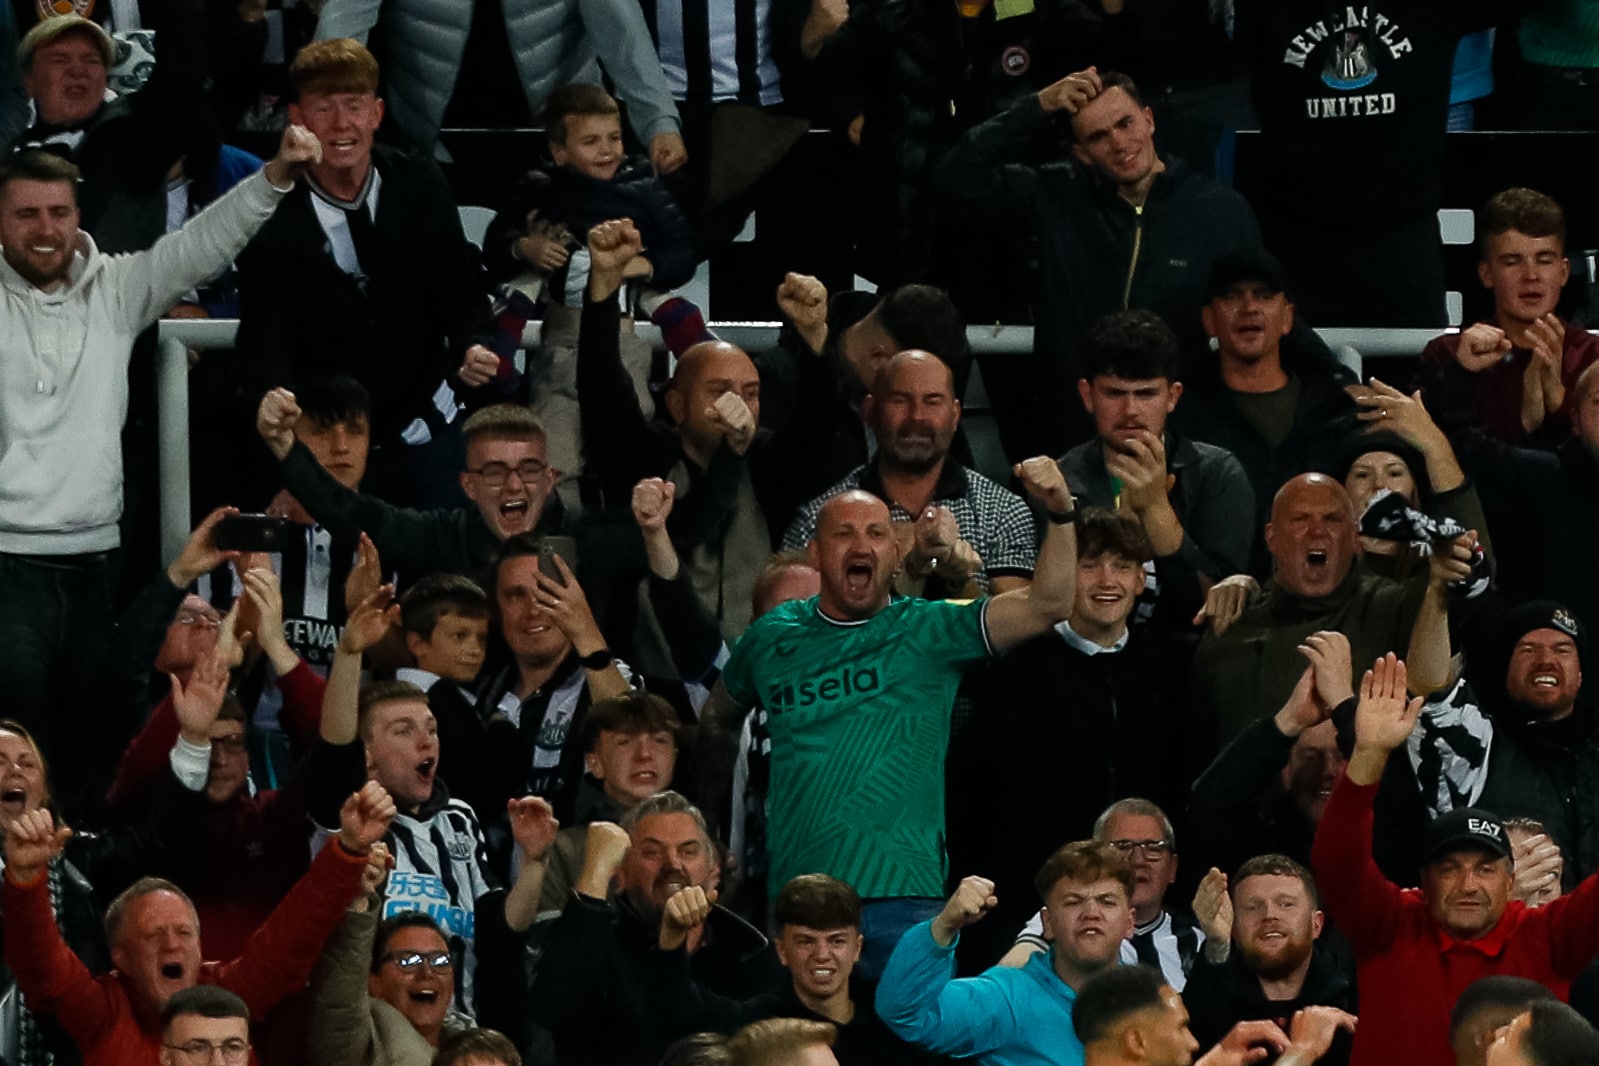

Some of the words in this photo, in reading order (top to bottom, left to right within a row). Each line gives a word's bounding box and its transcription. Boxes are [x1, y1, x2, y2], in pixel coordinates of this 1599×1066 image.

[1306, 92, 1397, 118] UNITED
[799, 666, 880, 707] sela
[1467, 818, 1501, 837] EA7
